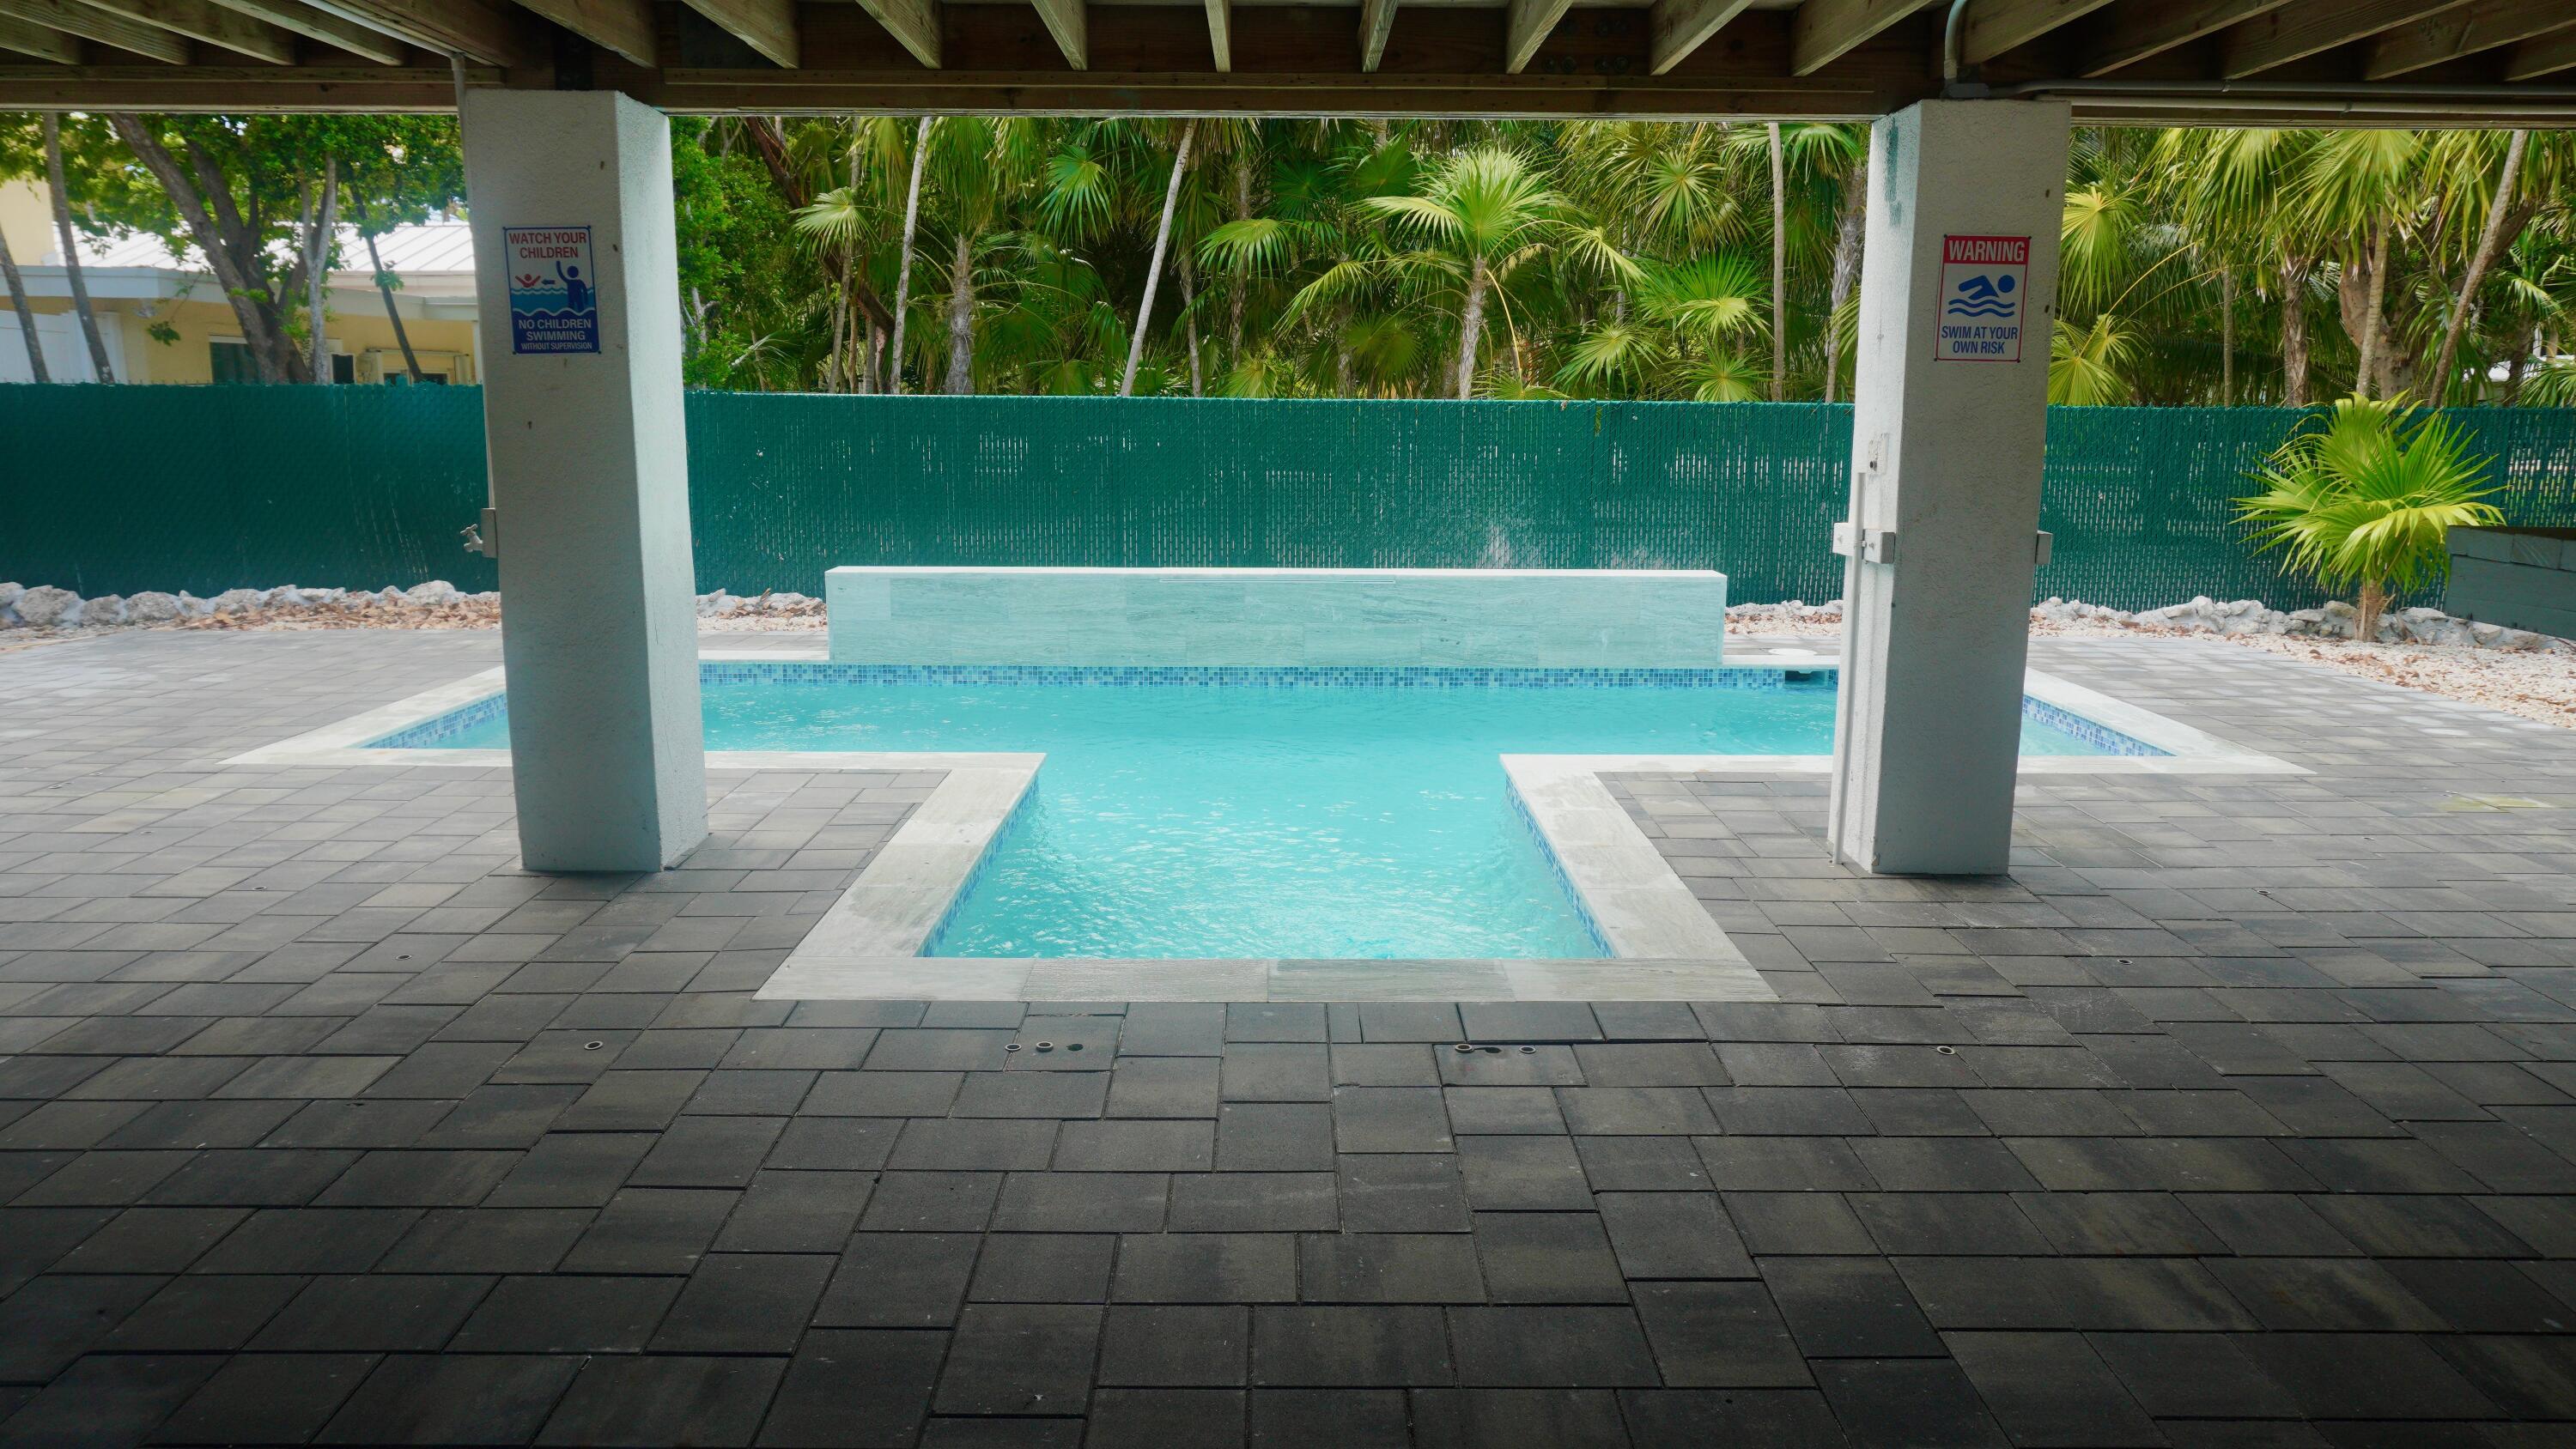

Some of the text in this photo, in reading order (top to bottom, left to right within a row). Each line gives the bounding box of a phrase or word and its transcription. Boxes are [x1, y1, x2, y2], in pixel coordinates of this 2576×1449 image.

[509, 232, 587, 244] WATCH YOUR
[519, 246, 579, 258] CHILDREN
[1948, 239, 2026, 262] WARNING
[518, 318, 592, 330] NO CHILDREN
[526, 330, 586, 341] SWIMMING
[1941, 325, 2018, 340] SWIM AT YOUR
[550, 342, 592, 350] SUPERVISION
[1953, 341, 2005, 355] OWN RISK
